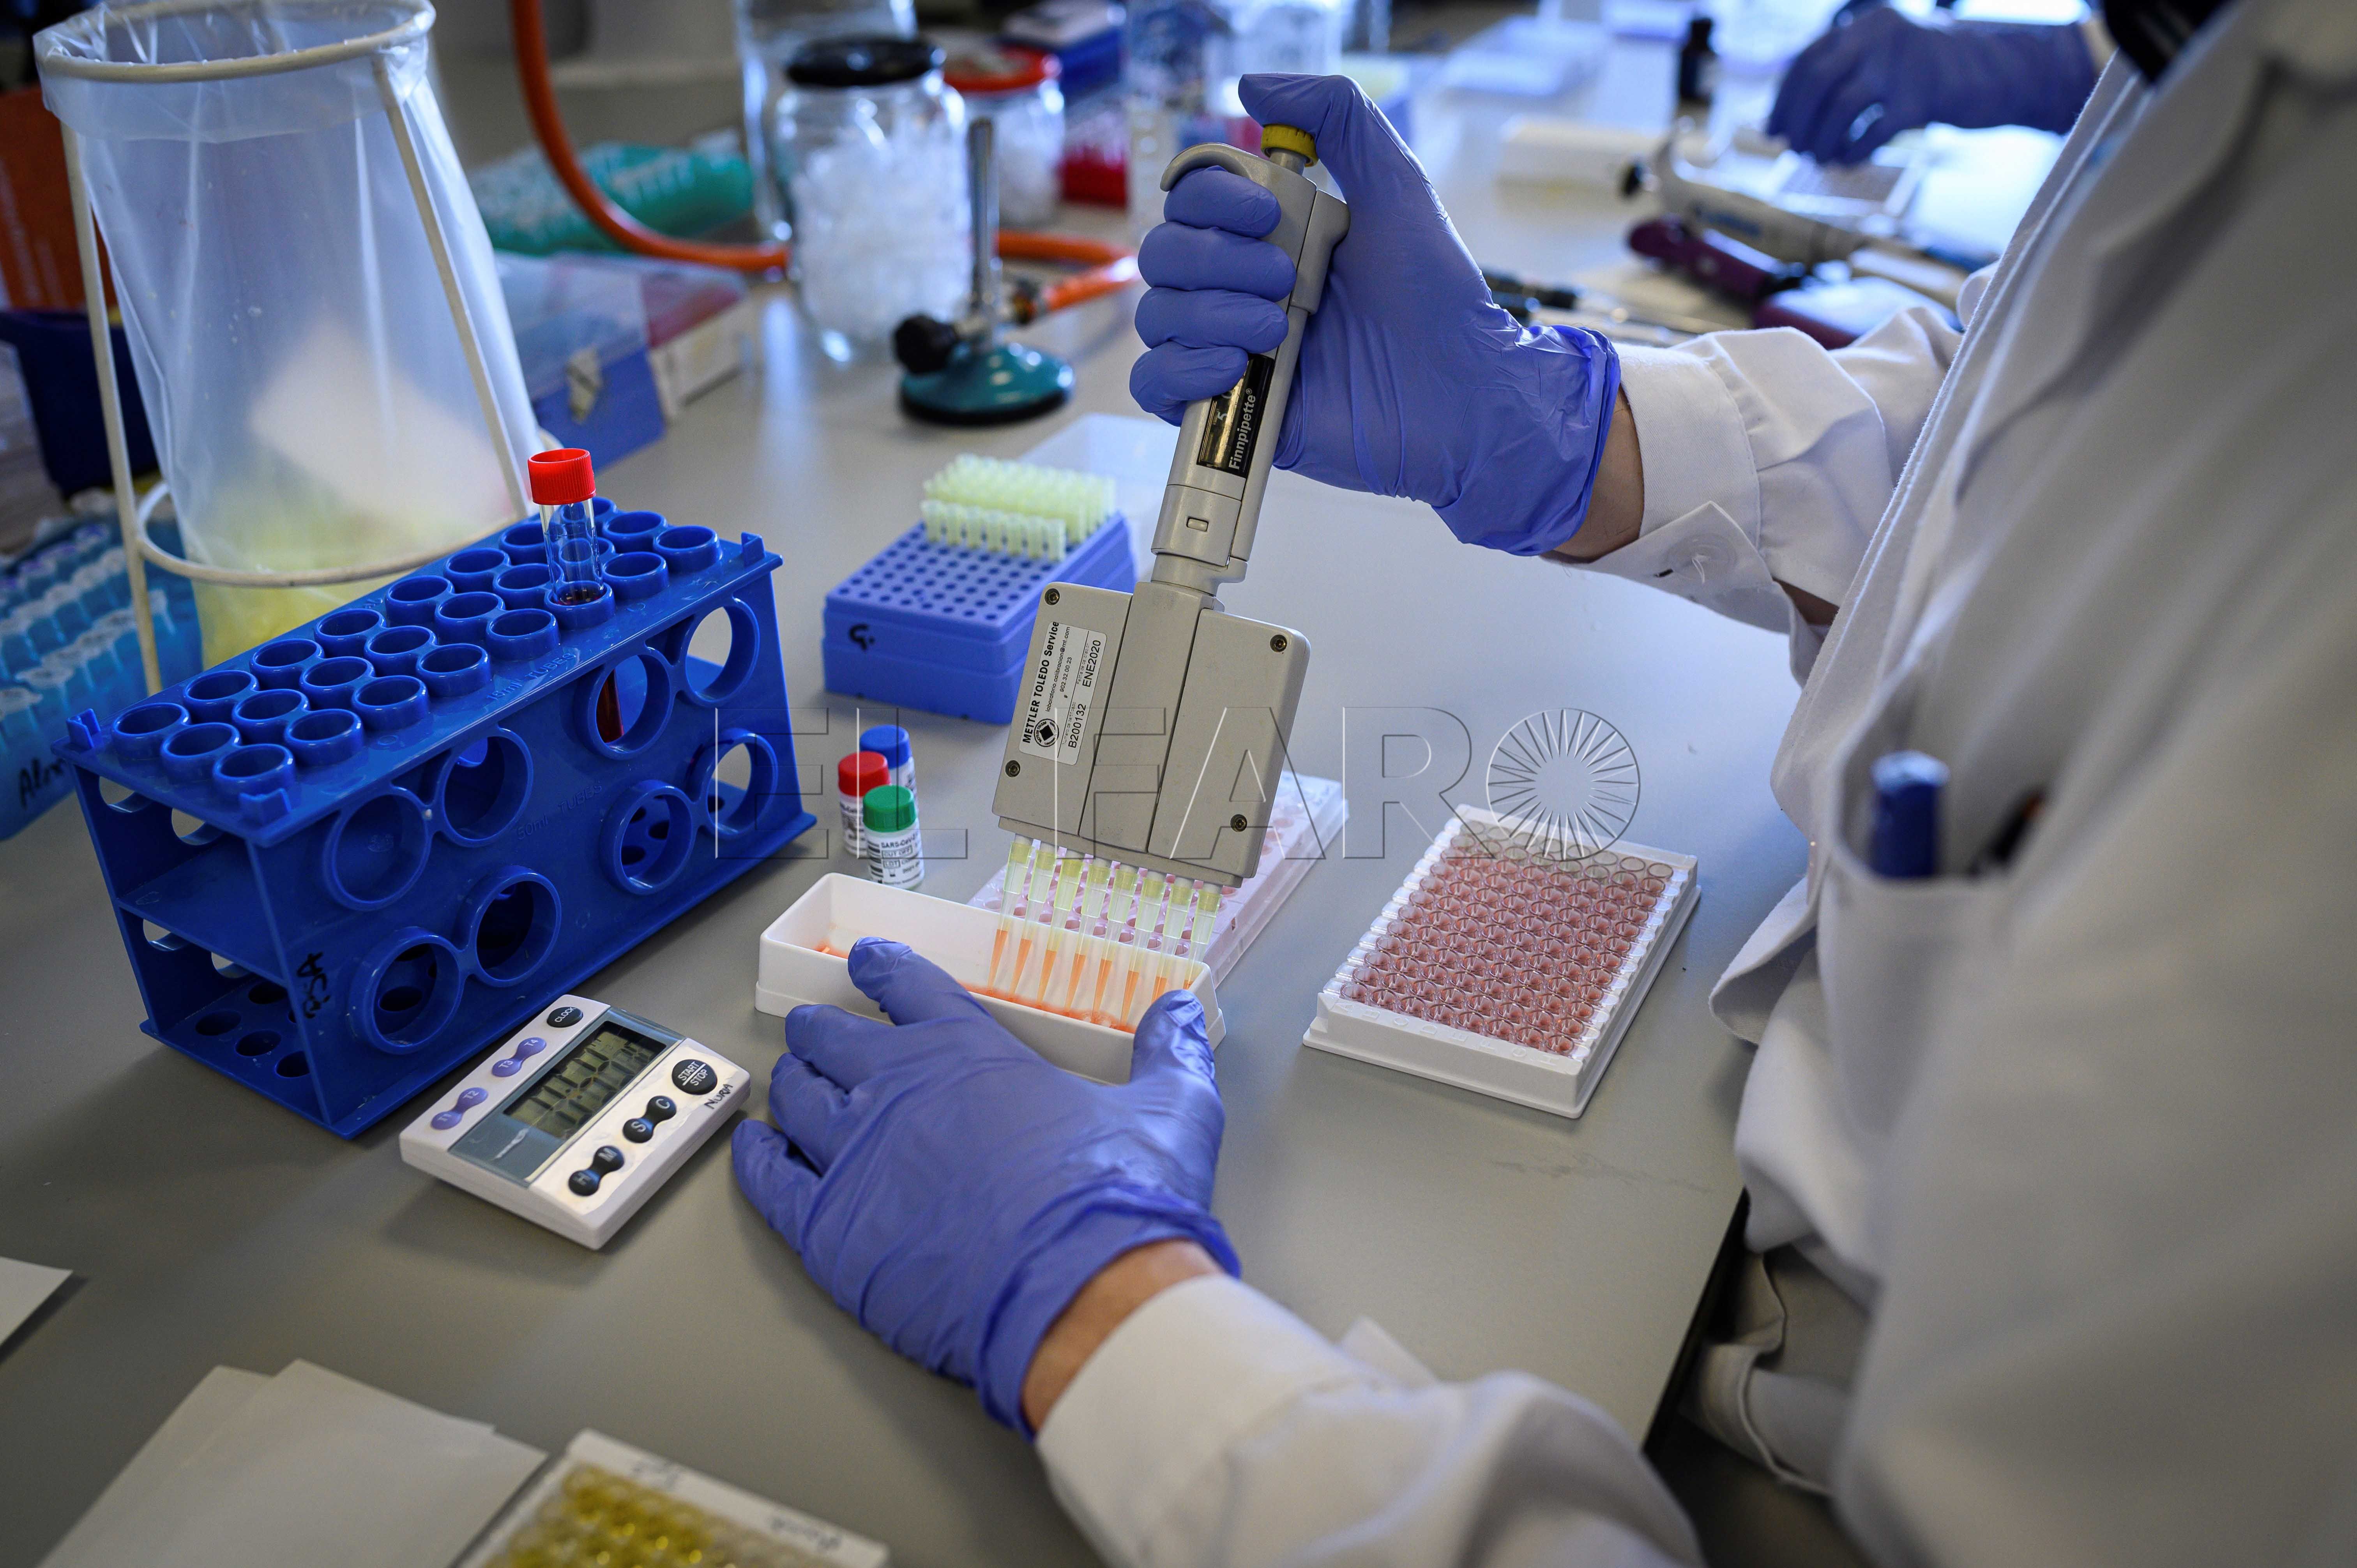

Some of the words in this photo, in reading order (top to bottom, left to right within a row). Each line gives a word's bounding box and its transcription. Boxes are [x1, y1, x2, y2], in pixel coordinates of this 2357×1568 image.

[525, 653, 576, 679] TUBES
[1045, 627, 1070, 712] laboratorio.calibracion@mt.com
[1082, 640, 1101, 687] ENE2020
[1022, 700, 1040, 743] METTLER
[1034, 660, 1050, 697] TOLEDO
[1044, 622, 1059, 657] Service
[1060, 657, 1072, 692] 902.32.00.23
[1068, 704, 1086, 748] B200132
[555, 1007, 576, 1022] CLOCK
[498, 1060, 514, 1068] T3
[677, 1061, 700, 1081] START
[690, 1069, 708, 1086] STOP
[463, 1090, 480, 1099] T2
[656, 1098, 670, 1109] C
[631, 1121, 646, 1132] S
[598, 1147, 618, 1162] M
[573, 1172, 591, 1186] H
